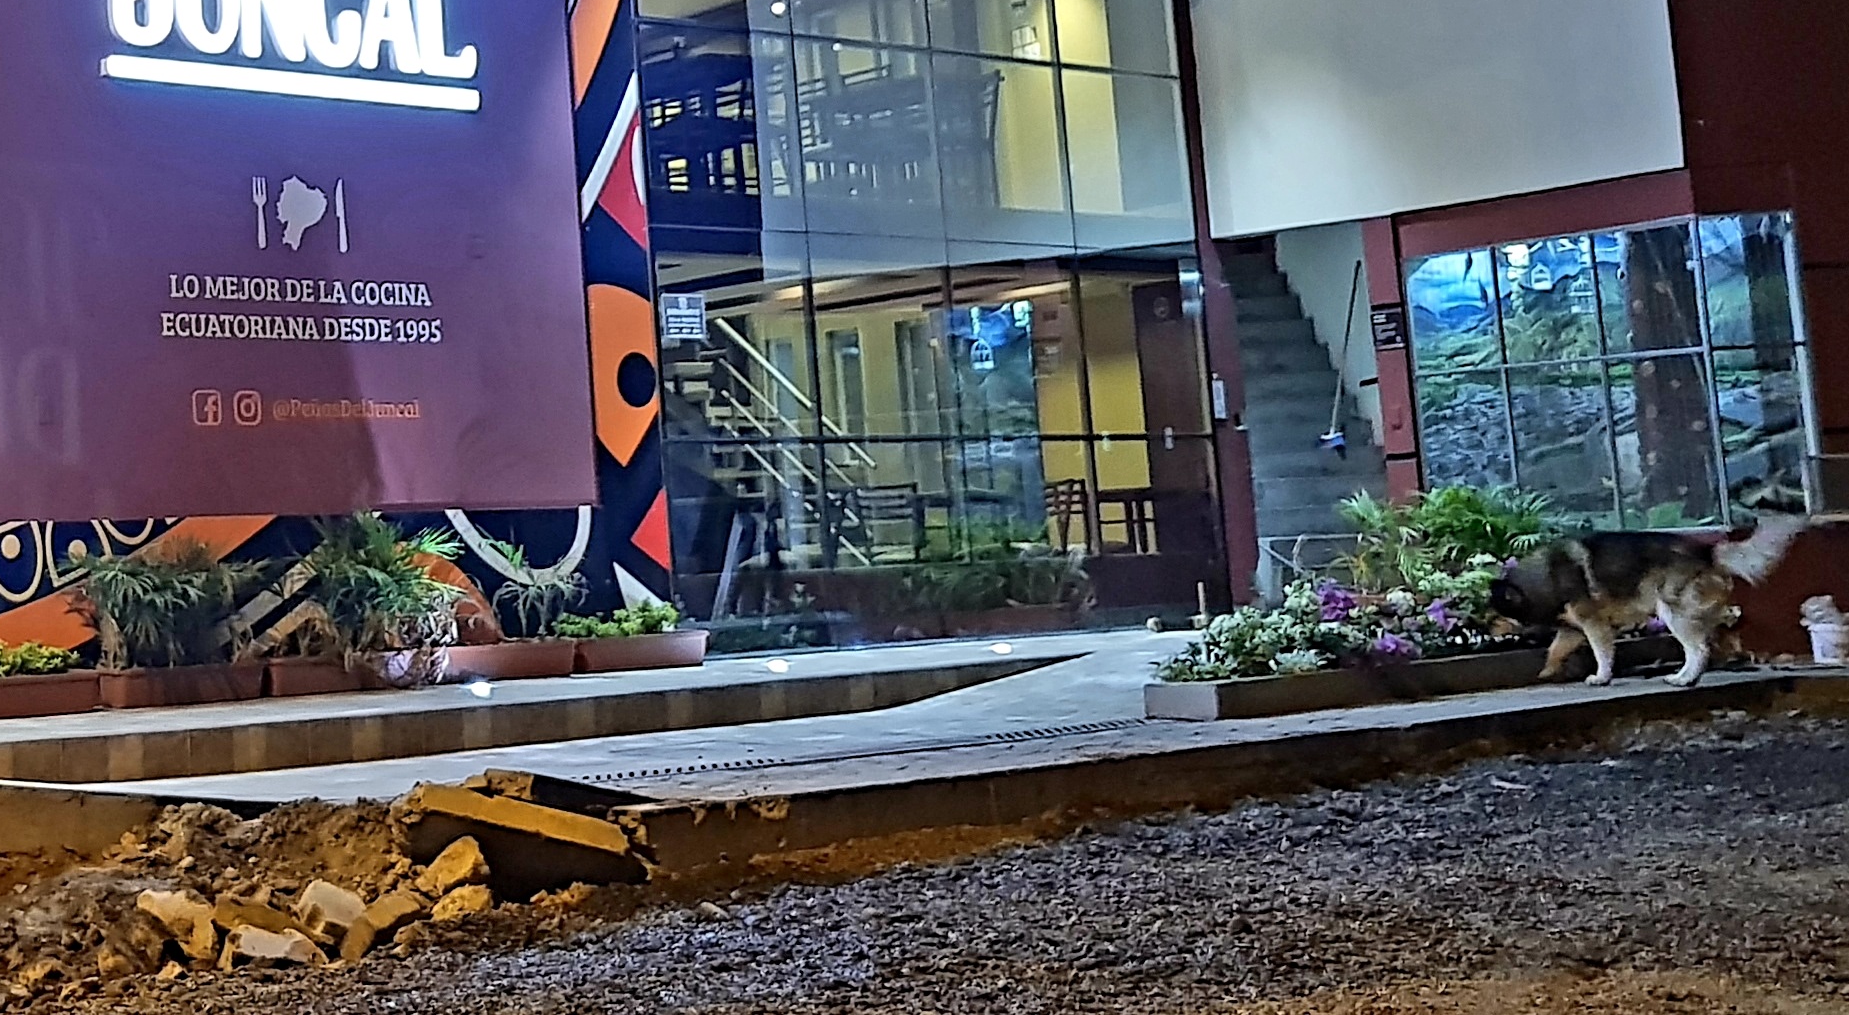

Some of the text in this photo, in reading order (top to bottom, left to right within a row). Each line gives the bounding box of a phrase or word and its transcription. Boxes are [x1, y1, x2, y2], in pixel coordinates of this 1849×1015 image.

[169, 274, 432, 307] LO MEJOR DE LA COCINA
[160, 312, 443, 344] ECUATORIANA DESDE 1995
